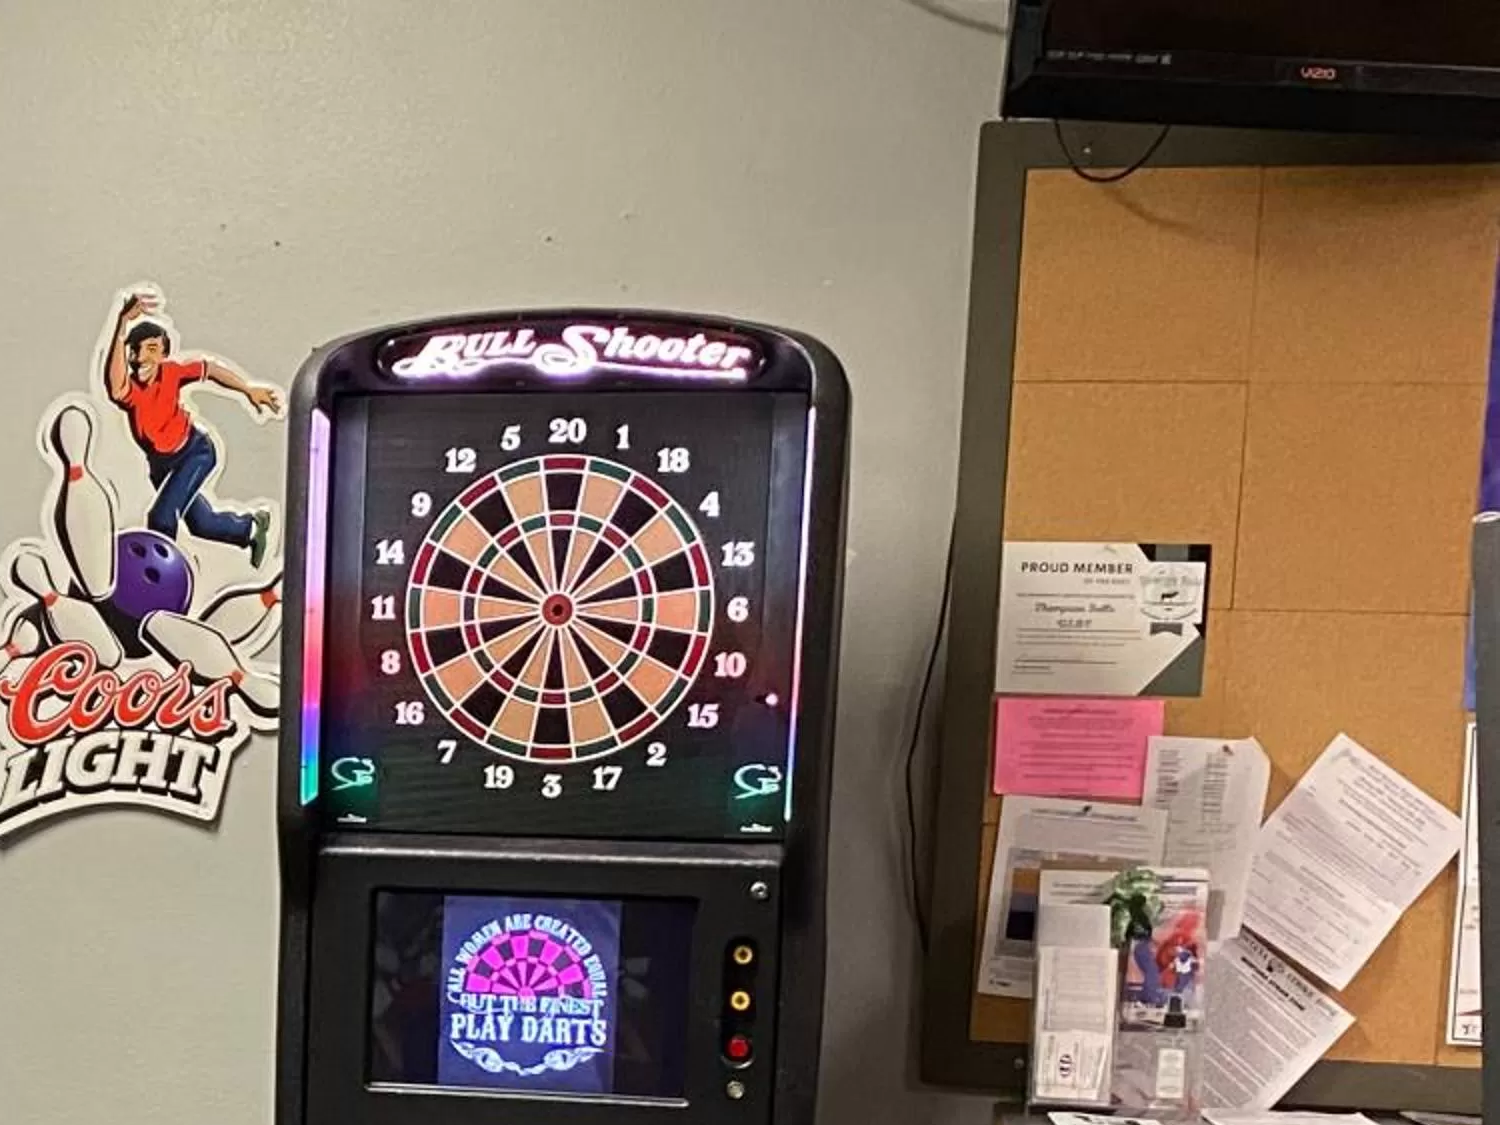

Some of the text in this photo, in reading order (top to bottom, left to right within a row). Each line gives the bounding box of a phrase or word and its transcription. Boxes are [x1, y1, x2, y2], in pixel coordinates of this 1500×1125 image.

[533, 325, 750, 379] Shooter
[500, 425, 521, 451] 5
[548, 417, 587, 444] 20
[616, 424, 630, 450] 1
[445, 447, 477, 473] 12
[657, 447, 690, 473] 18
[411, 491, 432, 518] 9
[699, 491, 720, 518] 4
[376, 539, 405, 565] 14
[721, 541, 755, 568] 13
[1021, 561, 1133, 575] PROUD MEMBER
[371, 595, 396, 620] 11
[727, 596, 749, 623] 6
[381, 649, 401, 675] 8
[714, 651, 747, 678] 10
[395, 701, 425, 725] 16
[687, 703, 719, 729] 15
[437, 739, 457, 764] 7
[646, 741, 667, 767] 2
[483, 764, 514, 789] 19
[541, 773, 562, 798] 3
[592, 765, 623, 791] 17
[447, 913, 608, 998] ALL WOMEN ARE CREATED EQUAL
[500, 995, 537, 1013] THE
[451, 1013, 607, 1046] PLAY DARTS
